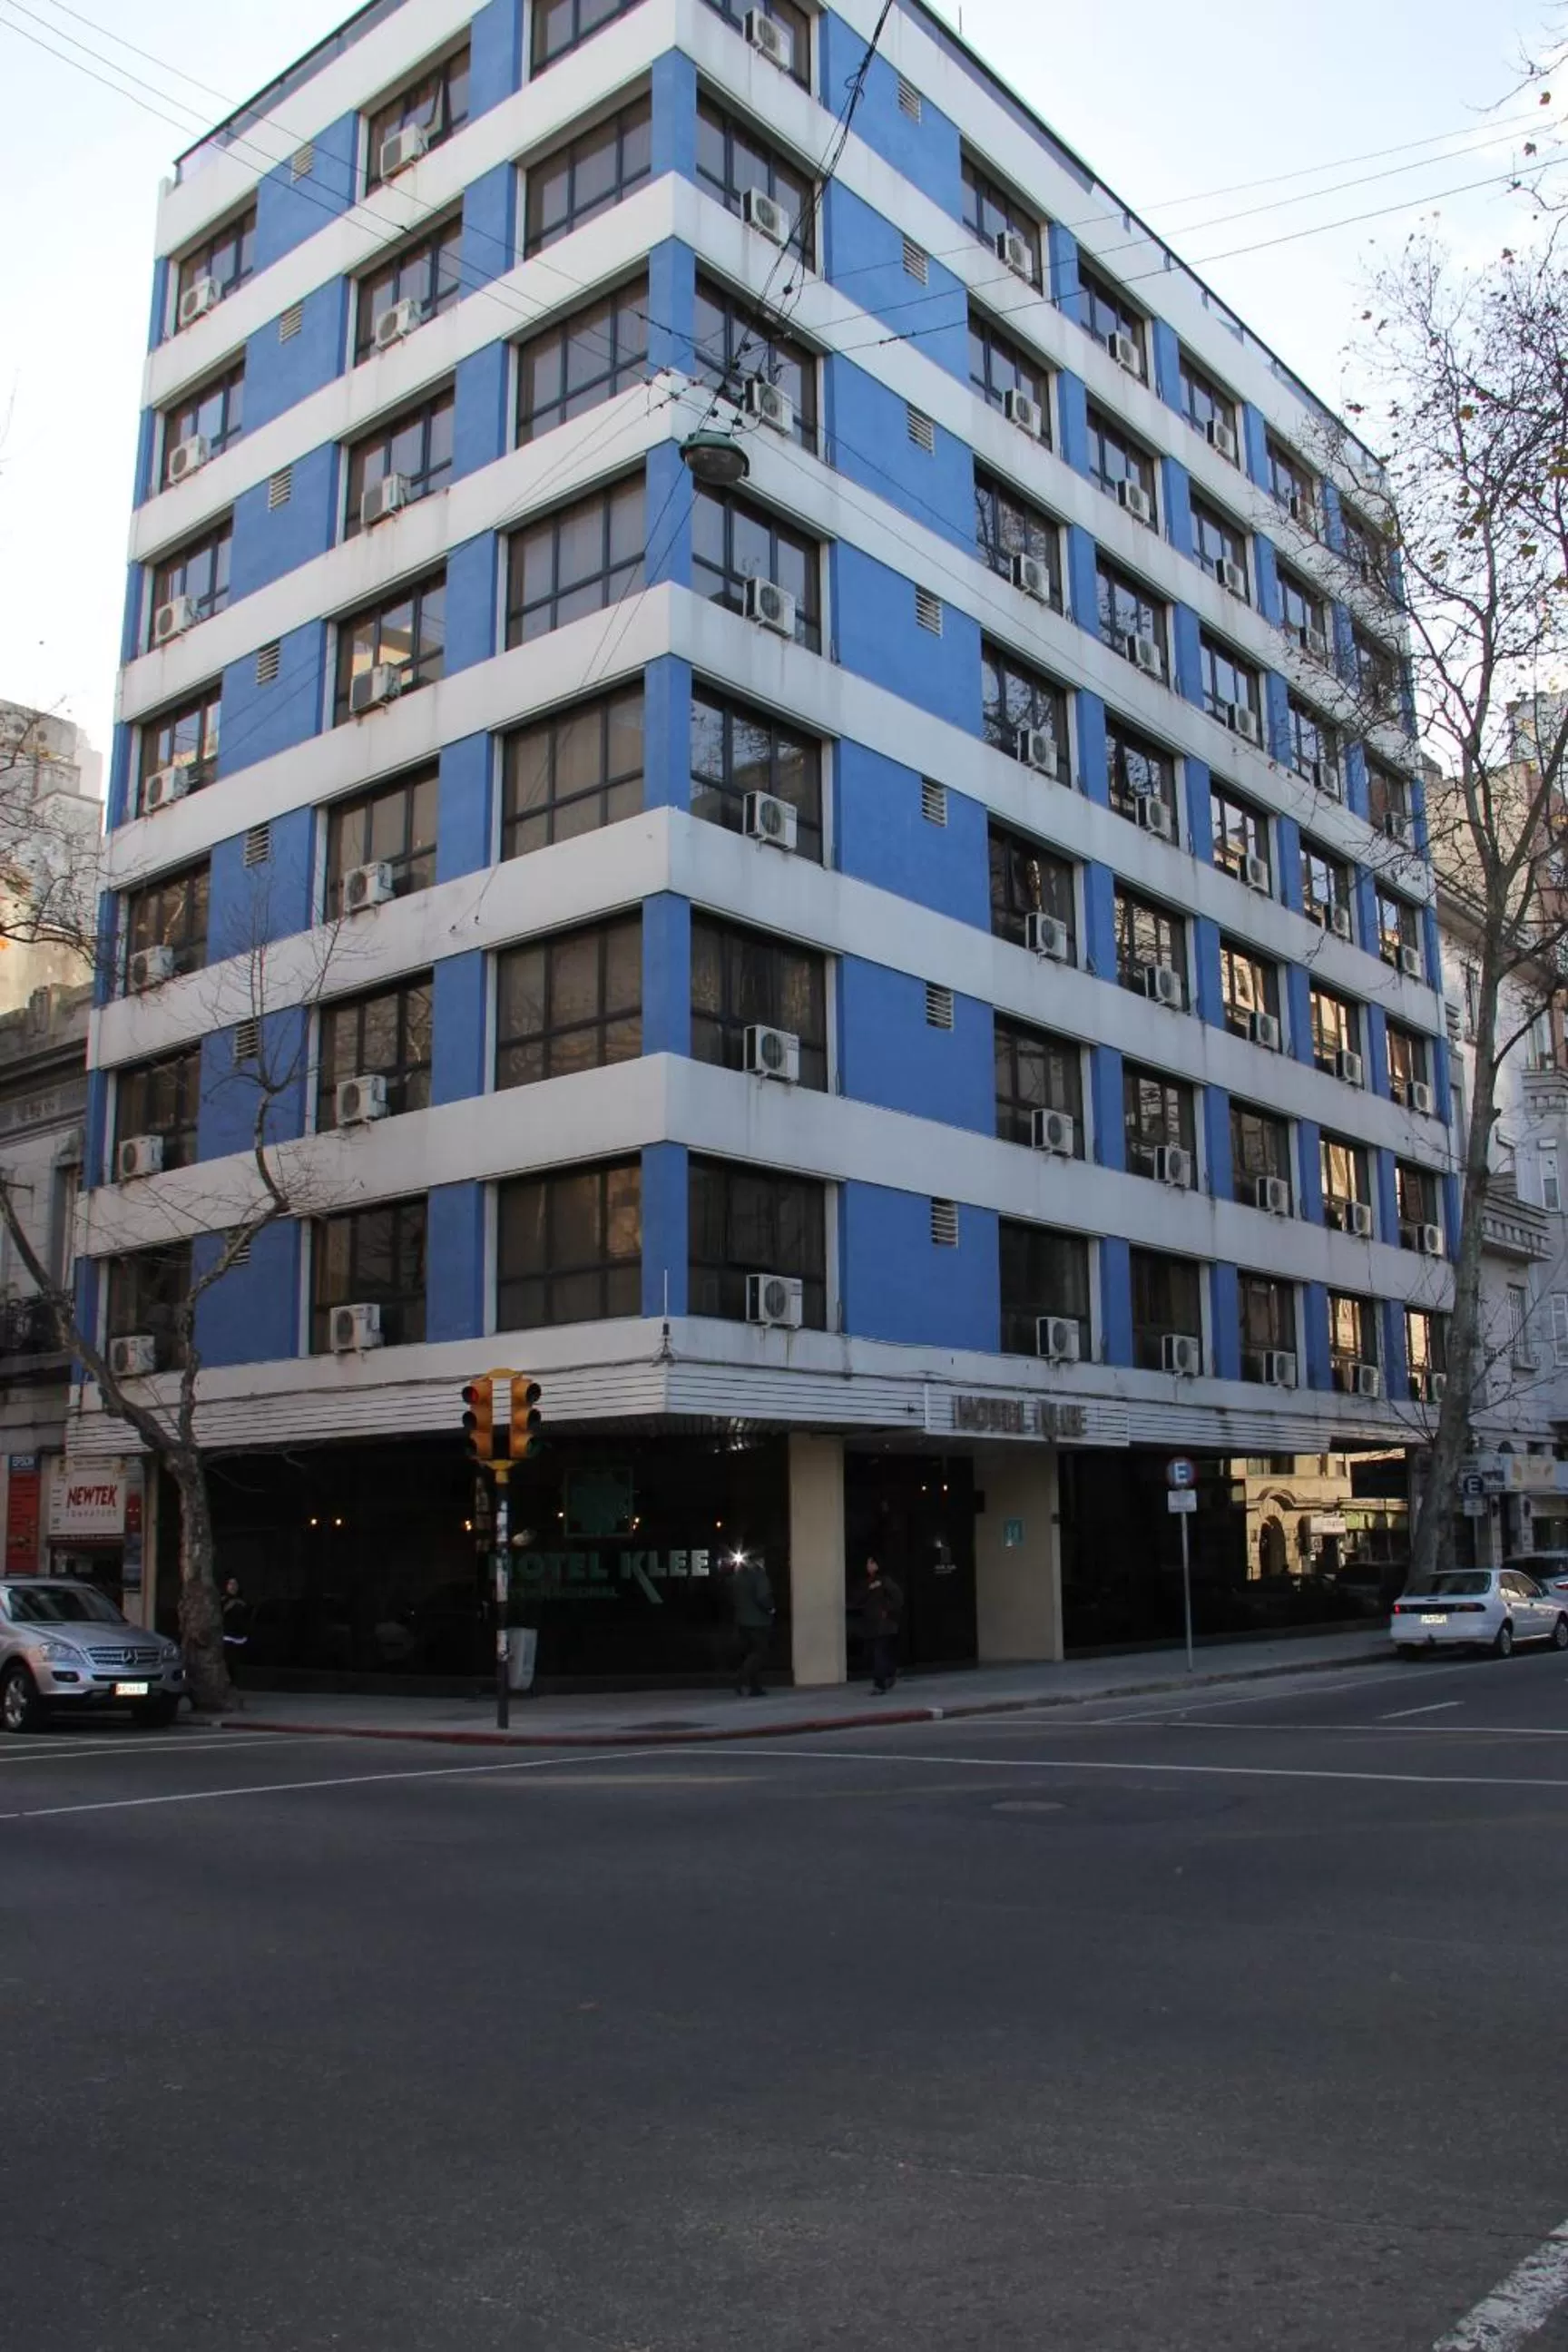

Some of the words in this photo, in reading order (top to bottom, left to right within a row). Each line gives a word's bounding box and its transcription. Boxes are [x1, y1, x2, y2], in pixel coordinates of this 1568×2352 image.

[1173, 1462, 1188, 1485] E
[67, 1485, 118, 1508] NEWTEK
[1467, 1477, 1480, 1494] E
[621, 1549, 710, 1603] KLEE
